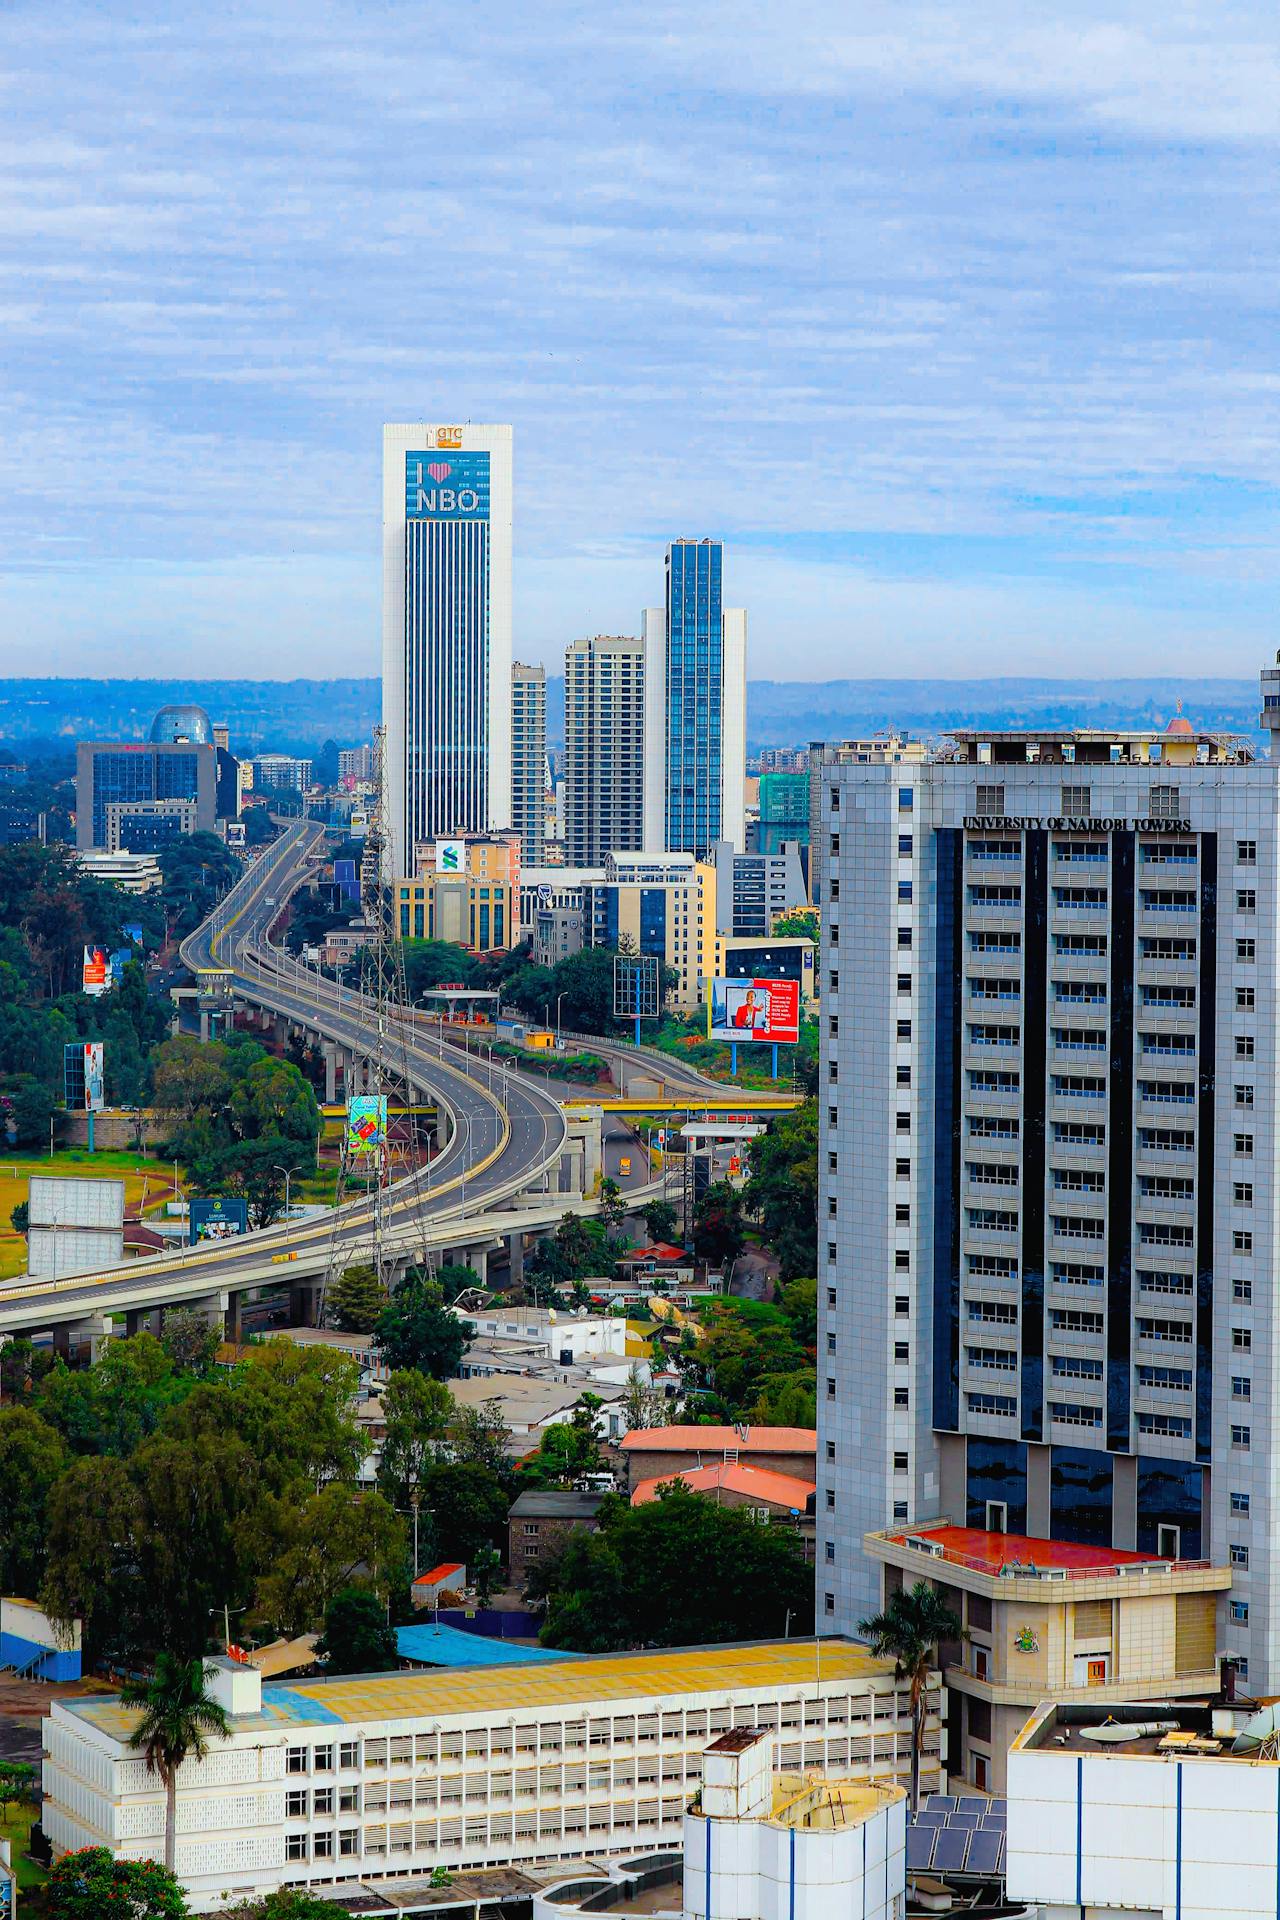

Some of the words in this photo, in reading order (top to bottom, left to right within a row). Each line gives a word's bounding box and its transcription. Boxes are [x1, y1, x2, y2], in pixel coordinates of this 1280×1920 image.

[437, 427, 463, 439] GTC
[416, 462, 423, 484] I
[416, 489, 479, 512] NBO
[962, 816, 1043, 830] UNIVERSITY
[1047, 816, 1066, 831] OF
[1067, 817, 1128, 832] NAIROBI
[1132, 818, 1191, 833] TOWERS
[764, 989, 772, 1016] ready
